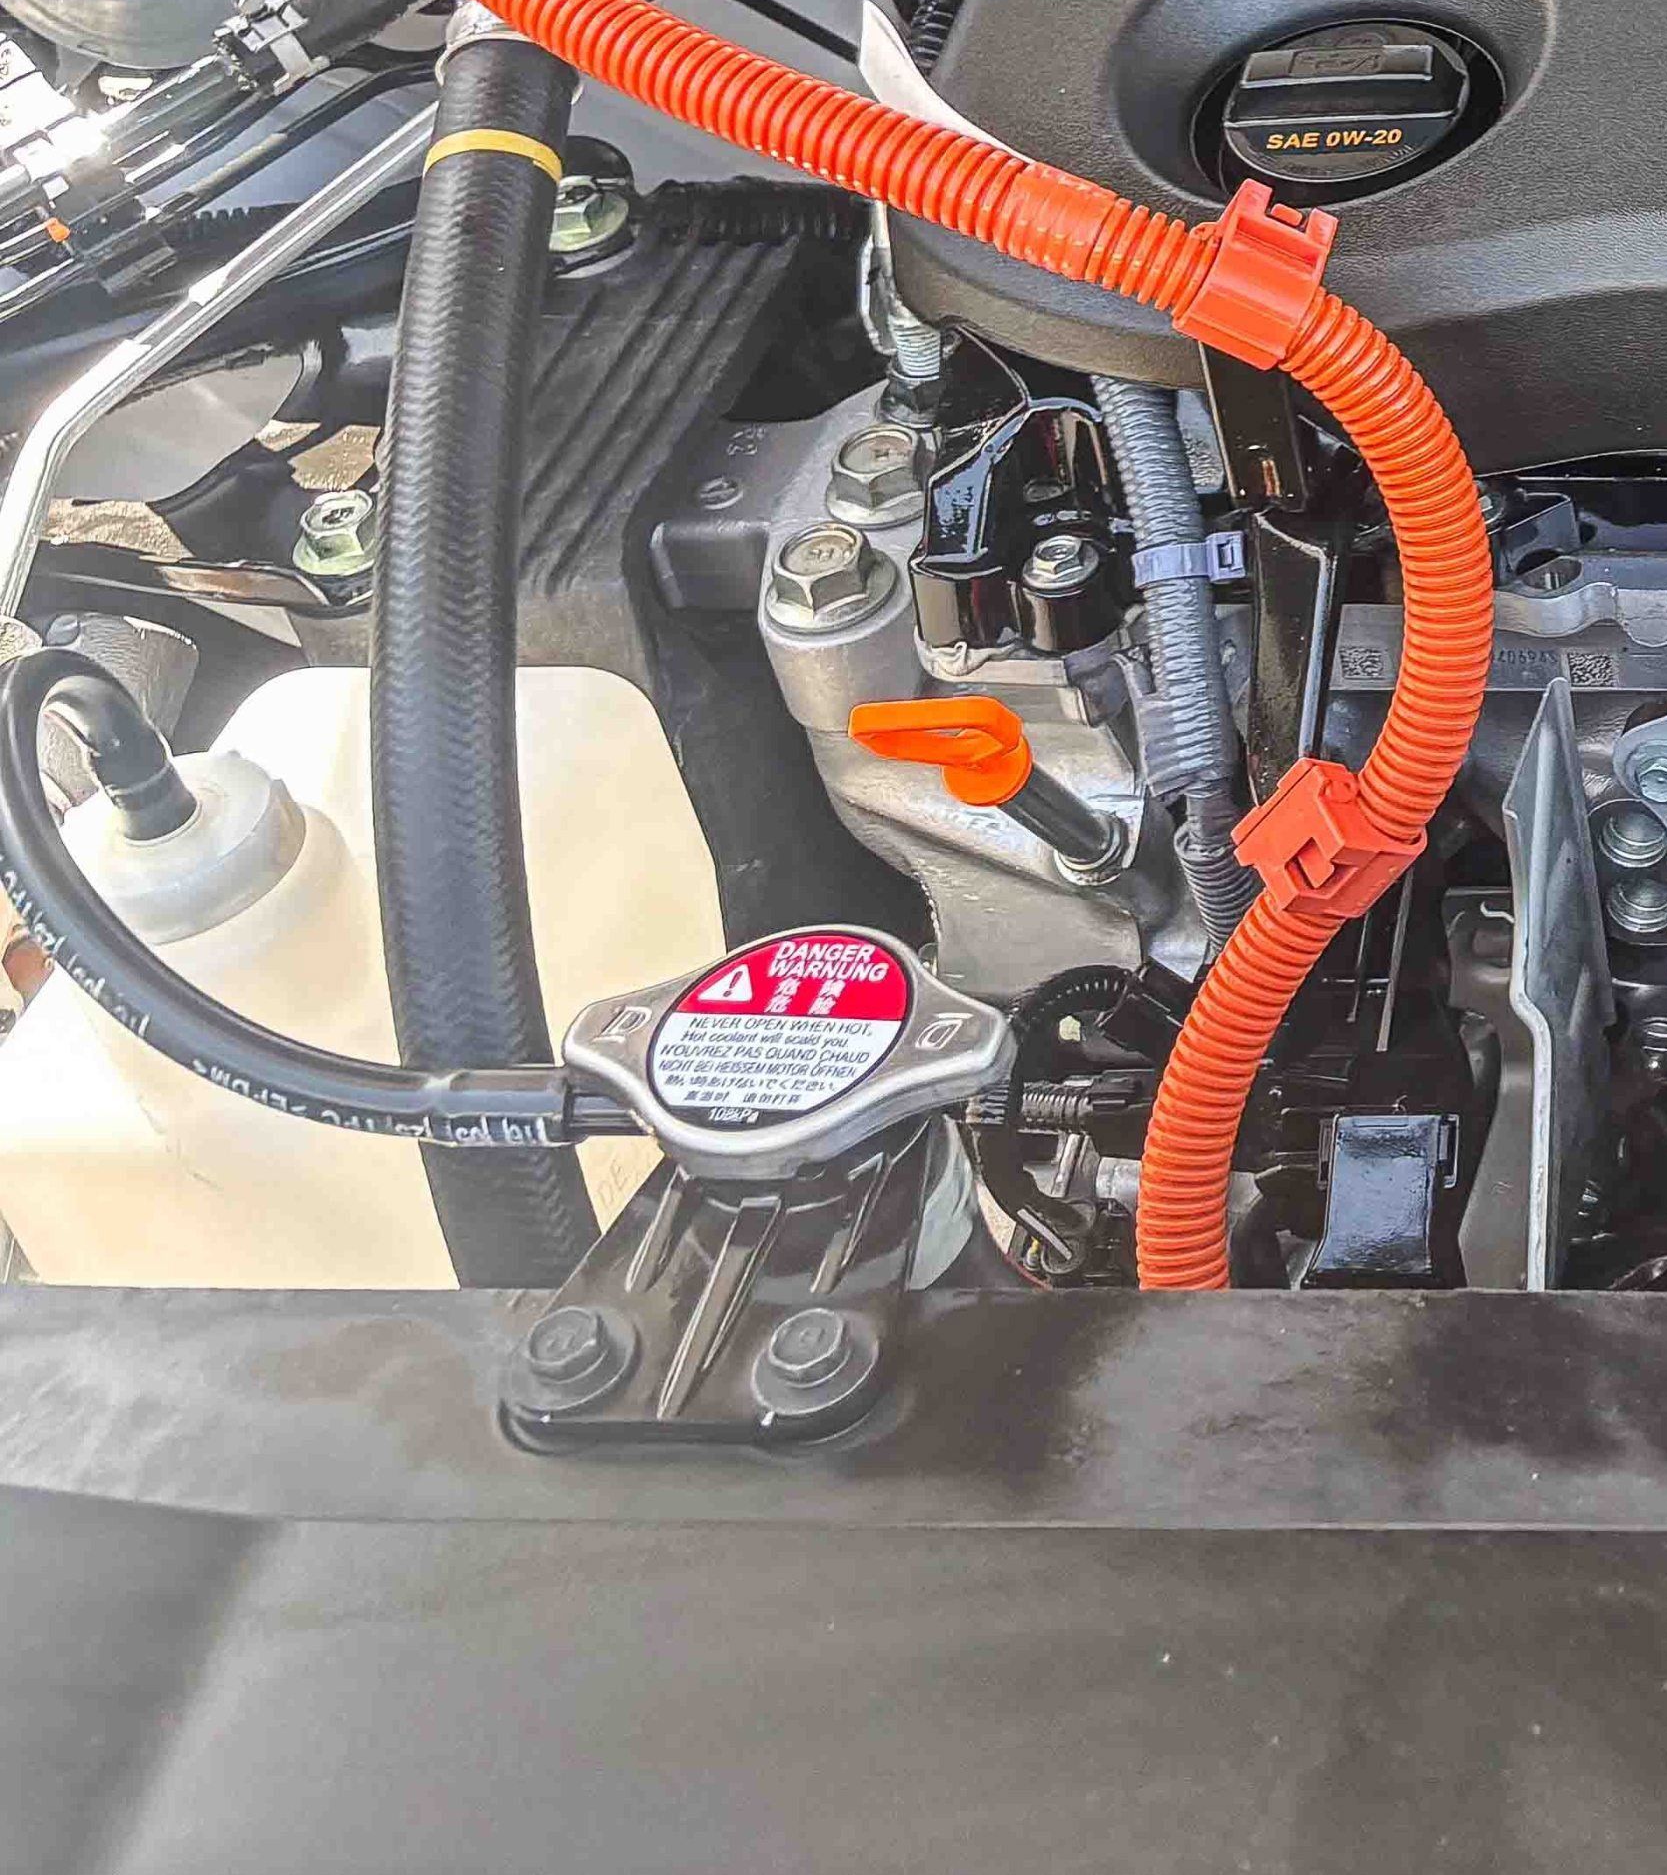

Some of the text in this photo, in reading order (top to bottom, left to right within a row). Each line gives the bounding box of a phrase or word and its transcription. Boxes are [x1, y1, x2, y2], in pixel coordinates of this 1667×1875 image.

[1265, 128, 1403, 150] SAE 0W-20
[775, 940, 877, 963] DANGER
[768, 959, 890, 982] WARNUNG
[688, 1016, 745, 1029] NEVER
[743, 1018, 786, 1031] OPEN
[788, 1020, 834, 1033] WHEN
[680, 1030, 706, 1042] Hot
[708, 1031, 759, 1044] coolant
[760, 1033, 784, 1044] will
[785, 1034, 822, 1045] scald
[733, 1046, 763, 1058] PAS
[765, 1047, 817, 1062] QUAND
[818, 1049, 870, 1064] CHAUD
[657, 1059, 693, 1073] NICHT
[693, 1061, 714, 1073] BEI
[766, 1062, 809, 1076] MOTOR
